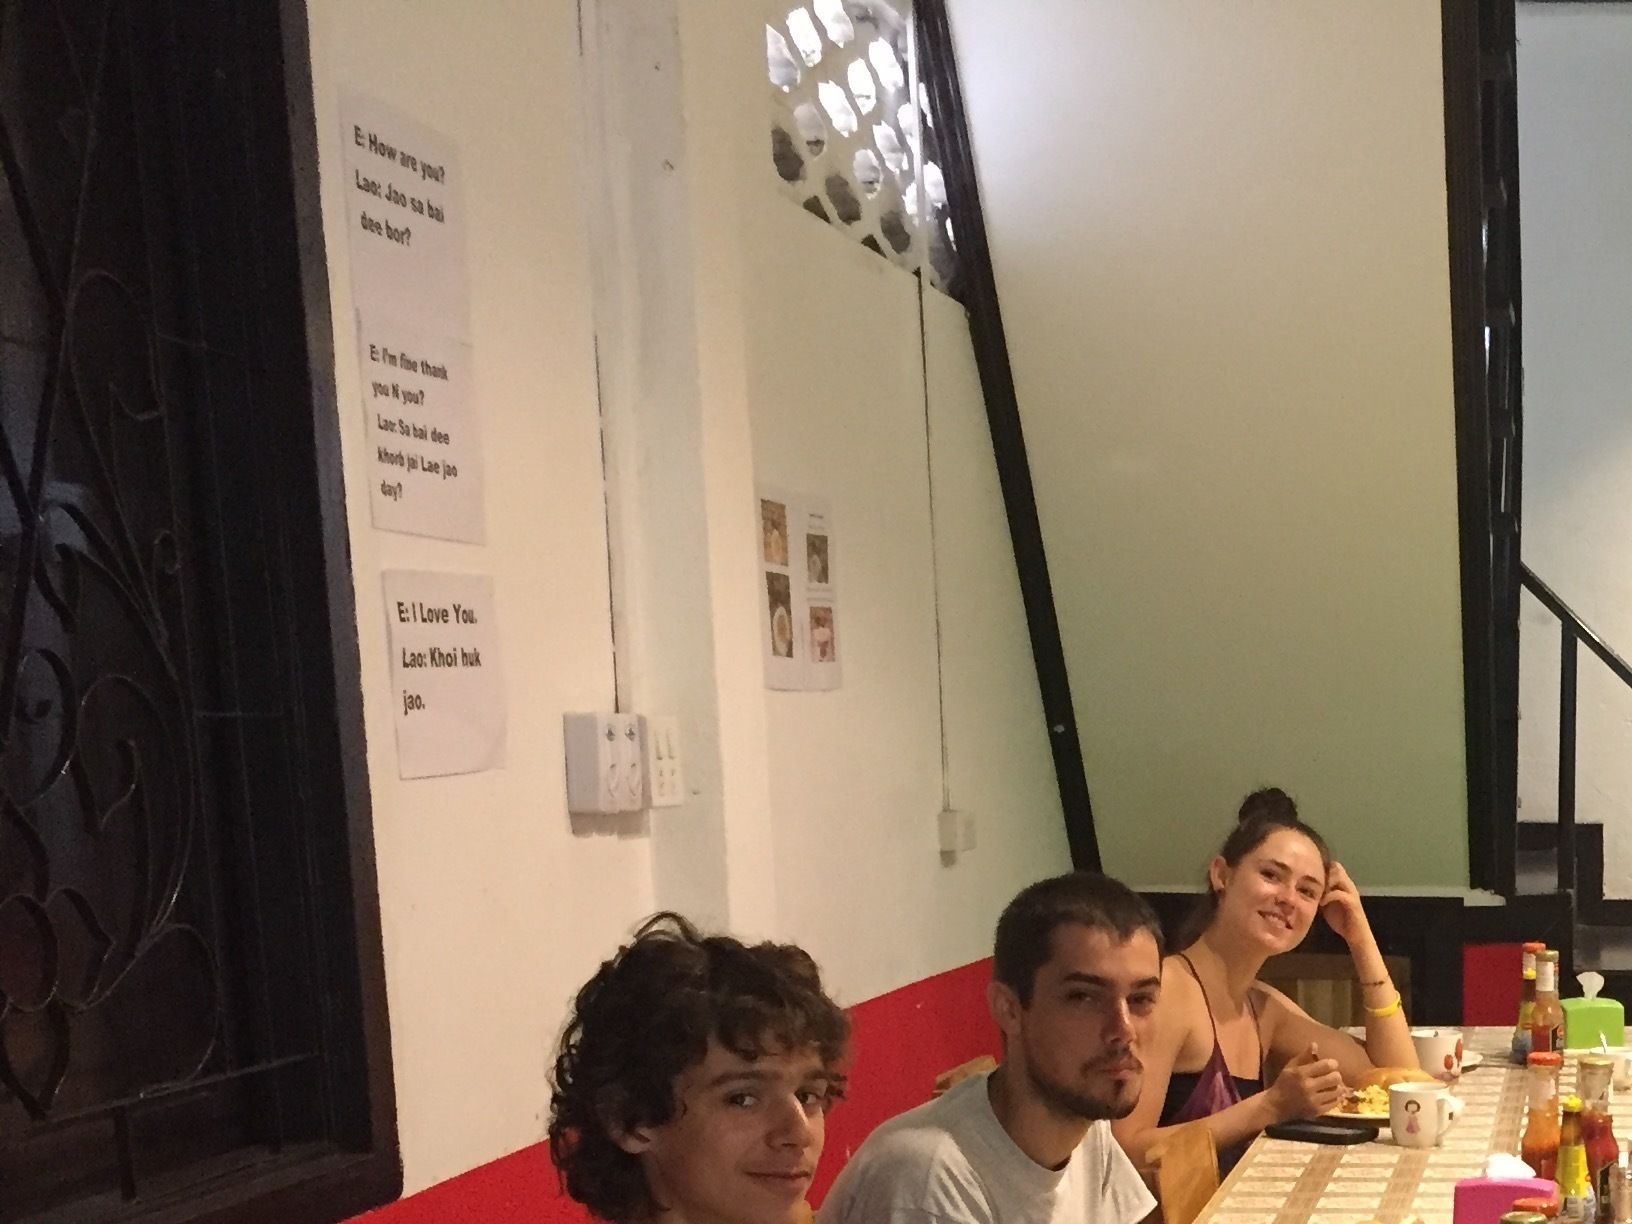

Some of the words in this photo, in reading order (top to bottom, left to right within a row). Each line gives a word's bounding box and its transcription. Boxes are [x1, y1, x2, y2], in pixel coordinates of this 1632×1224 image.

[368, 132, 397, 161] How
[400, 151, 417, 172] are
[420, 160, 445, 184] you?
[400, 352, 418, 373] fine
[421, 359, 448, 380] thank
[371, 381, 389, 398] you
[401, 389, 425, 406] you?
[430, 427, 450, 446] dee
[421, 455, 440, 474] Lae
[442, 460, 458, 480] jao
[397, 601, 410, 622] E:
[419, 602, 449, 624] Love
[453, 603, 478, 624] You.
[402, 647, 427, 668] Lao:
[429, 647, 457, 668] Khoi
[403, 689, 425, 716] jao.
